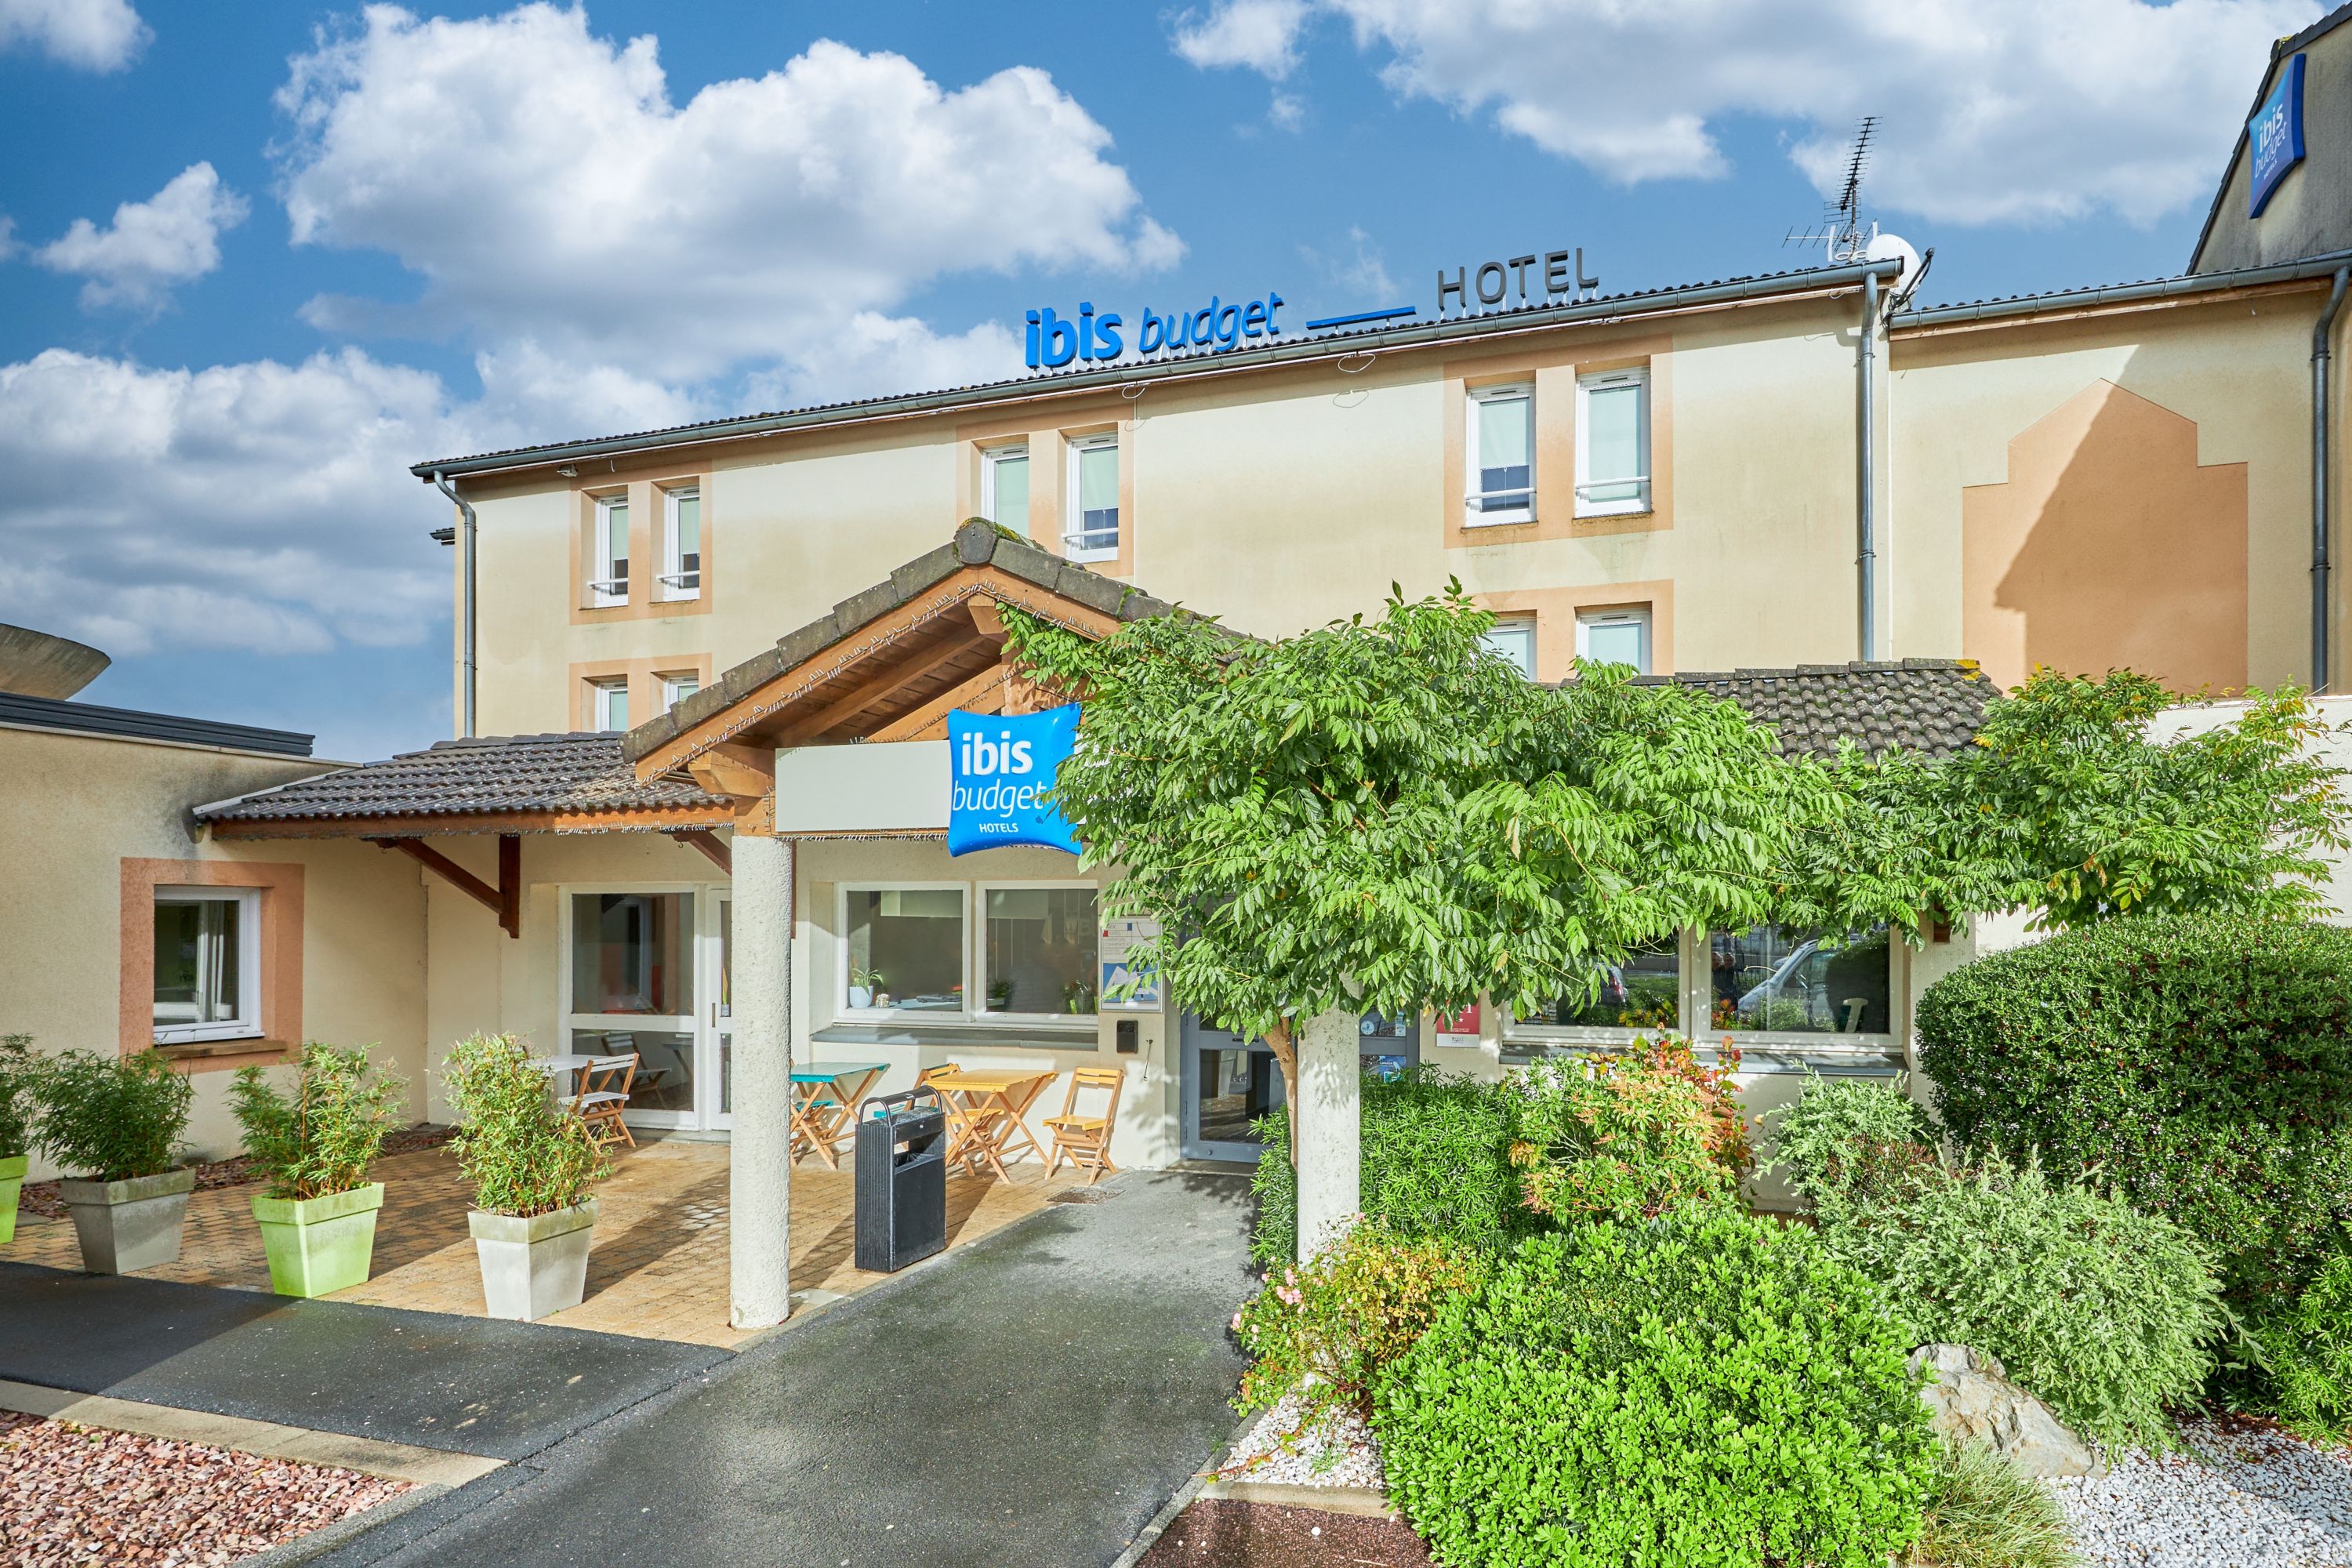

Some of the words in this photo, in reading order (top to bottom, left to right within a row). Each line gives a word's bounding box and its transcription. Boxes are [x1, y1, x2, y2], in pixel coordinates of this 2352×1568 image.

[2255, 121, 2288, 179] budget
[2259, 103, 2283, 154] ibis
[1025, 302, 1123, 368] ibis
[1138, 292, 1284, 351] budget
[1438, 247, 1599, 309] HOTEL
[962, 731, 1033, 776] ibis
[953, 779, 1047, 818] budget
[978, 822, 1019, 833] HOTELS
